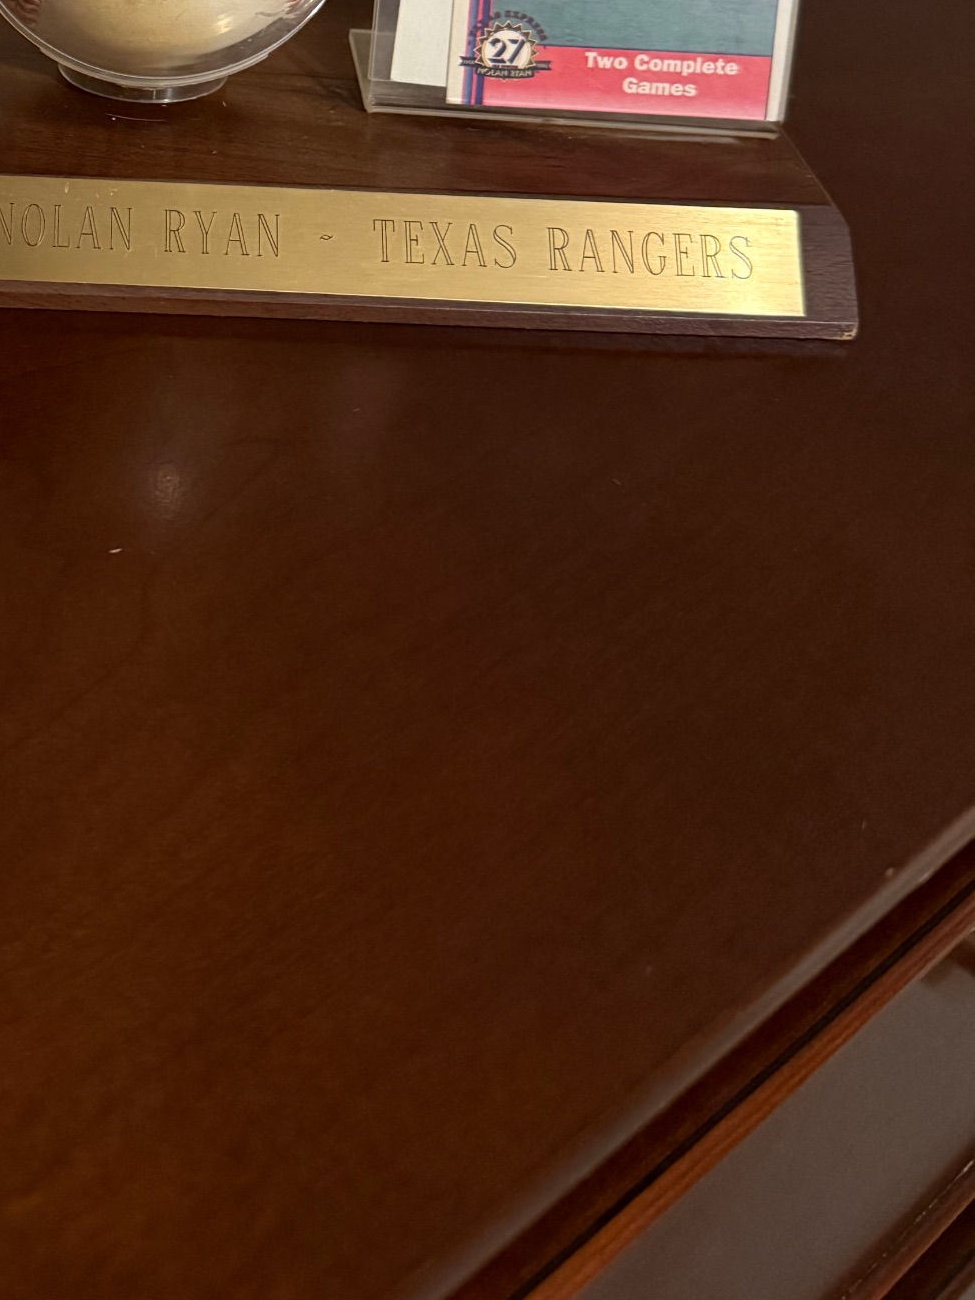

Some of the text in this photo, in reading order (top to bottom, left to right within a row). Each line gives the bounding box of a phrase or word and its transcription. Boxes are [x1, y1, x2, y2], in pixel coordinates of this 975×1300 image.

[487, 37, 526, 65] 27
[584, 51, 739, 76] Two Complete
[621, 76, 699, 97] Games
[163, 208, 281, 257] RYAN
[372, 218, 517, 269] TEXAS
[545, 226, 754, 280] RANGERS
